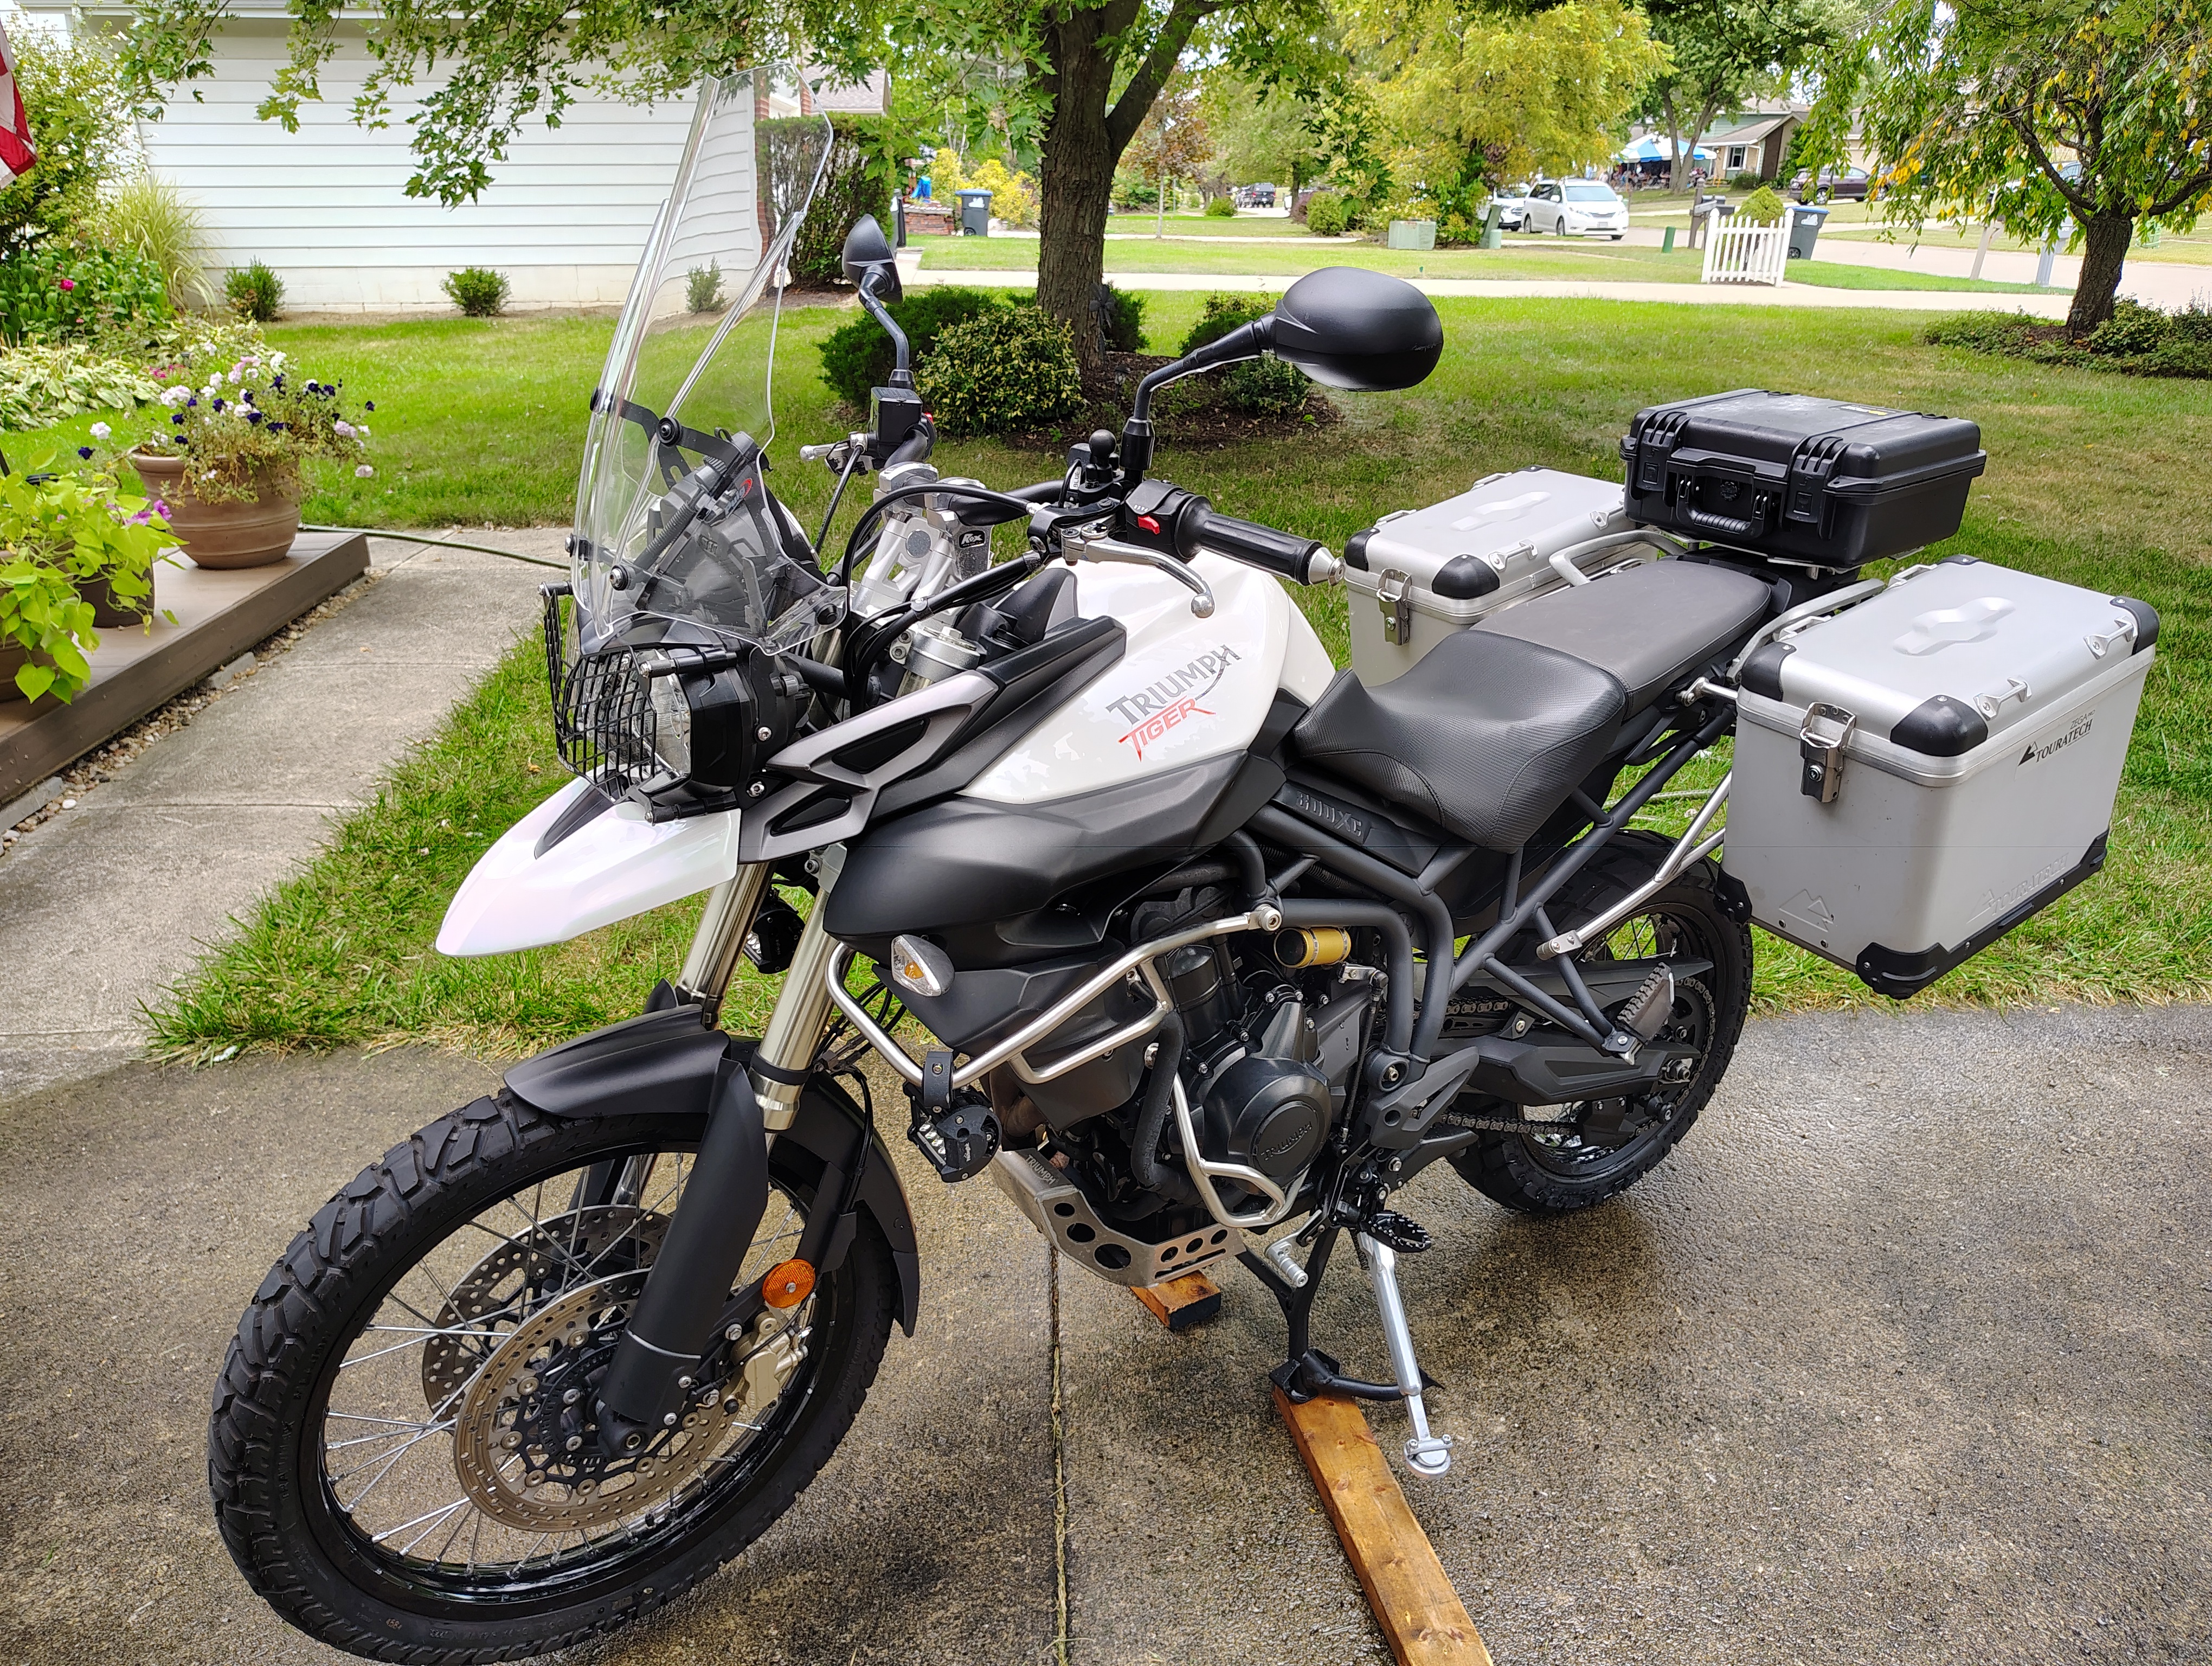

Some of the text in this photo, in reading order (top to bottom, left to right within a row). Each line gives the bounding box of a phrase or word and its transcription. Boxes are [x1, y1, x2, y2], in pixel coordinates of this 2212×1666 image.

[1105, 643, 1242, 726] TRIUMPH
[1117, 696, 1216, 762] TIGER
[2035, 718, 2093, 763] TOURATECH
[2069, 709, 2095, 730] ZEGA PRO
[1991, 852, 2069, 916] TOURATECH
[1261, 1120, 1312, 1161] TRIUMPH
[1026, 1154, 1056, 1185] TRIUMPH
